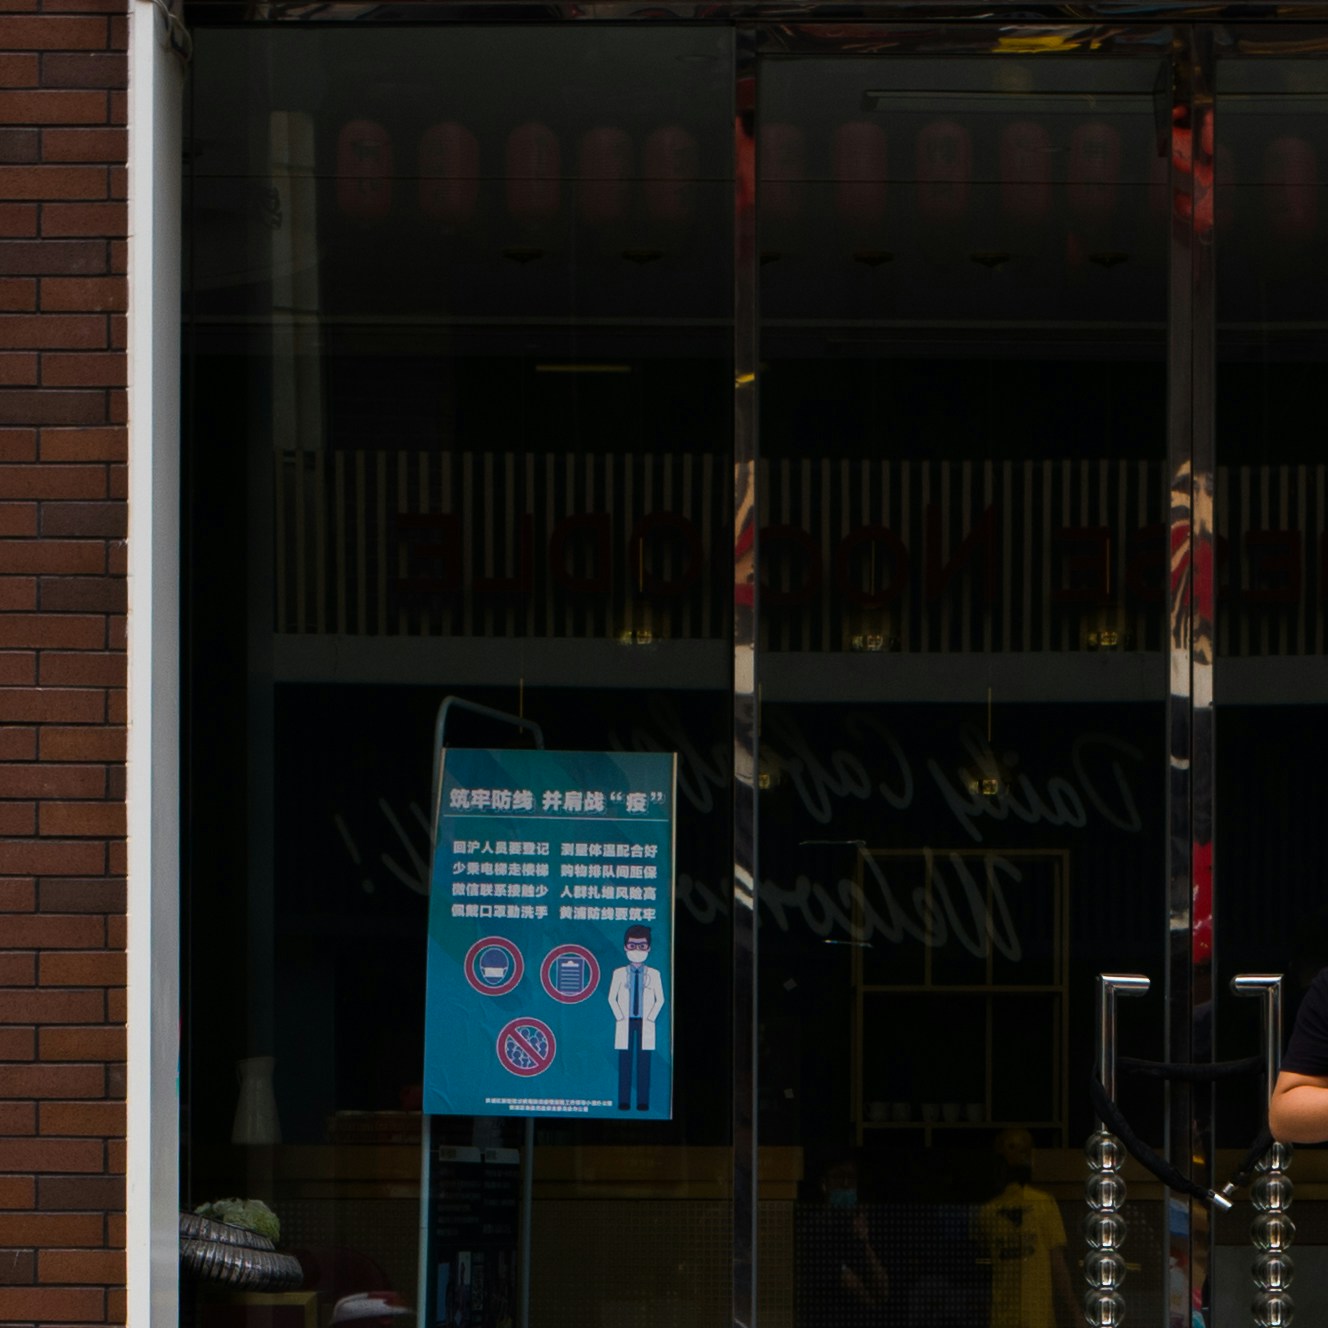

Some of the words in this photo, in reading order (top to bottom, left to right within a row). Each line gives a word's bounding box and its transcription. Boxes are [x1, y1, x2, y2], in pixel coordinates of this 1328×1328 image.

[449, 788, 534, 811] 筑牢防线
[453, 841, 550, 857] 回沪人员要登记
[560, 843, 658, 859] 测量体温配合好
[452, 862, 549, 878] 少乘电梯走楼梯
[451, 903, 548, 920] 佩戴口罩勤洗手
[559, 906, 656, 922] 黄浦防线要筑牢
